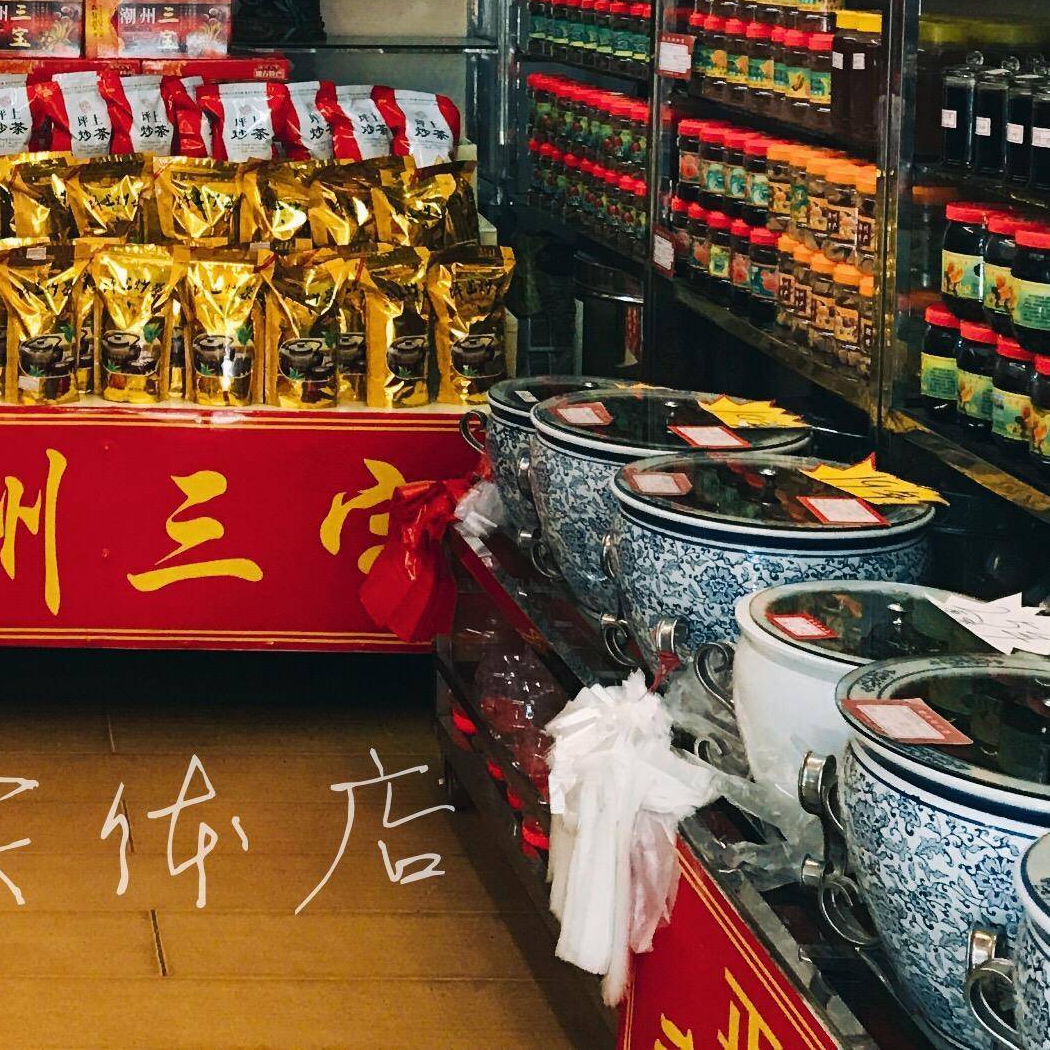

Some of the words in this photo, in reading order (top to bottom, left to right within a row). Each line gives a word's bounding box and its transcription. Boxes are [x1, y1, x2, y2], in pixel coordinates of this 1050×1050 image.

[120, 7, 156, 24] 潮州
[78, 127, 110, 142] 炒茶
[140, 125, 170, 138] 炒茶
[230, 127, 270, 140] 炒茶
